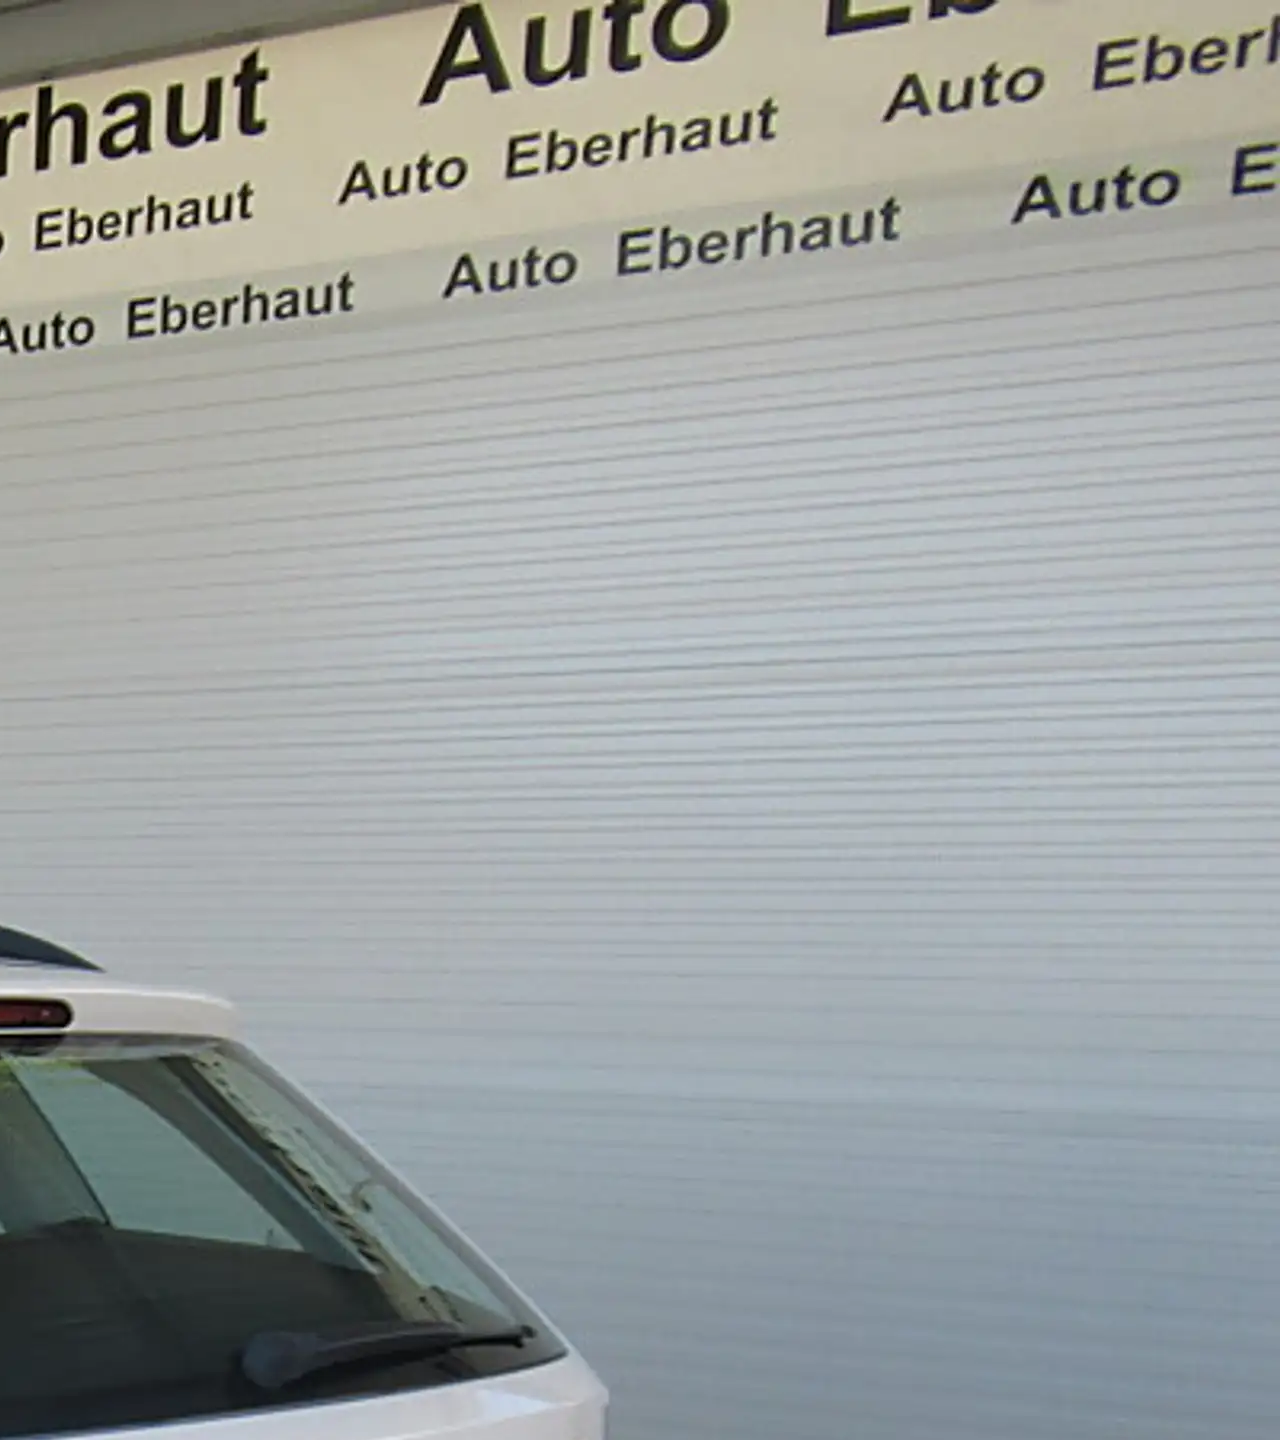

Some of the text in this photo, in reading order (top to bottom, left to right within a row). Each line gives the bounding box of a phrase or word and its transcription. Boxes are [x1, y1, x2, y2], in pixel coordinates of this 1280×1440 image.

[419, 0, 730, 107] Auto
[882, 63, 1046, 123] Auto
[338, 98, 778, 205] Auto Eberhaut
[35, 183, 255, 251] Eberhaut
[1011, 164, 1182, 225] Auto
[443, 197, 901, 299] Auto Eberhaut
[127, 272, 355, 339] Eberhaut
